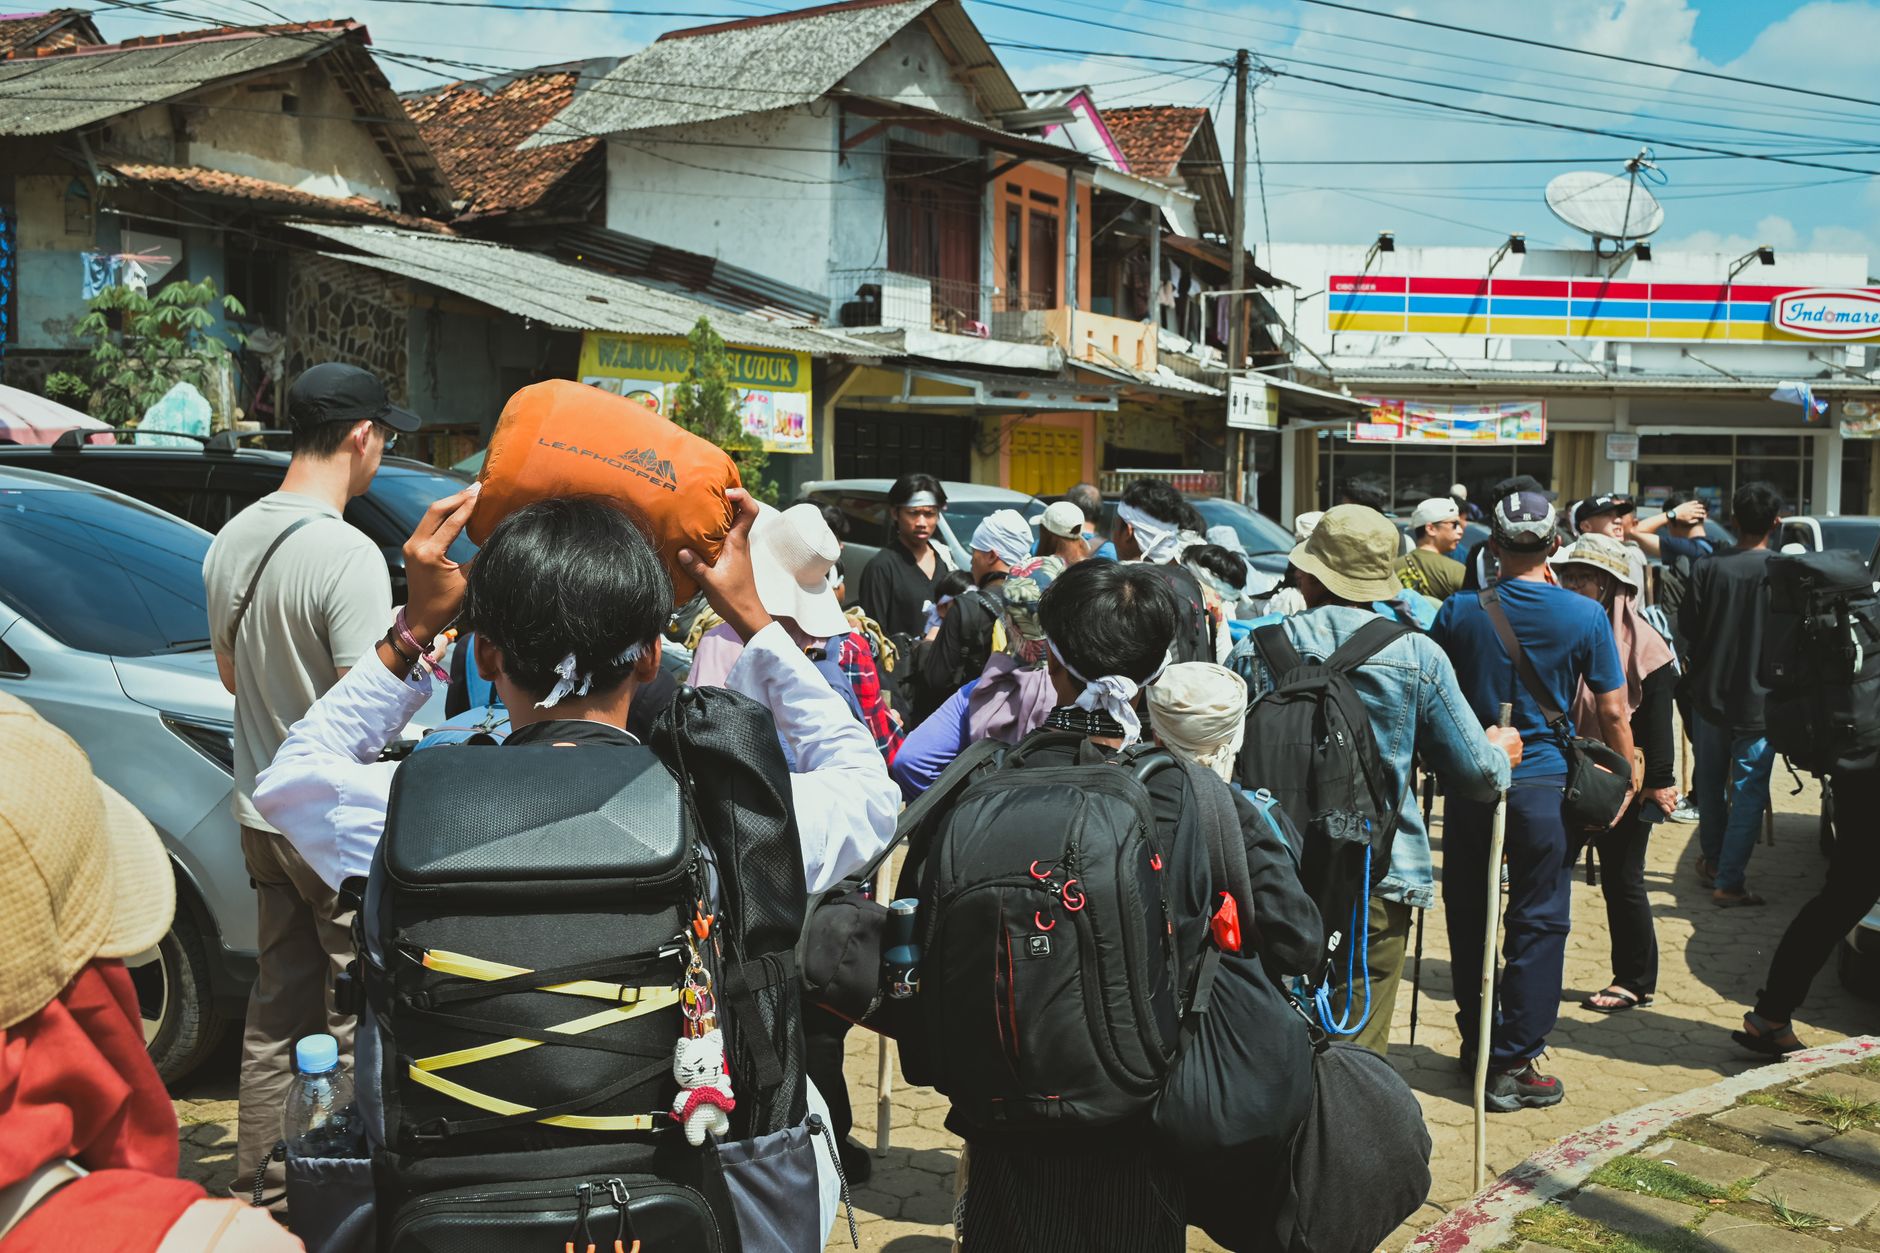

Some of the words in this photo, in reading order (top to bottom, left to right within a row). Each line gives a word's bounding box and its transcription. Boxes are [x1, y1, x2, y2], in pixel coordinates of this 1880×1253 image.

[1786, 303, 1880, 323] Indomare
[598, 338, 690, 373] WARUNG
[744, 354, 793, 383] UDUK
[538, 438, 677, 491] LEAFHOPPER
